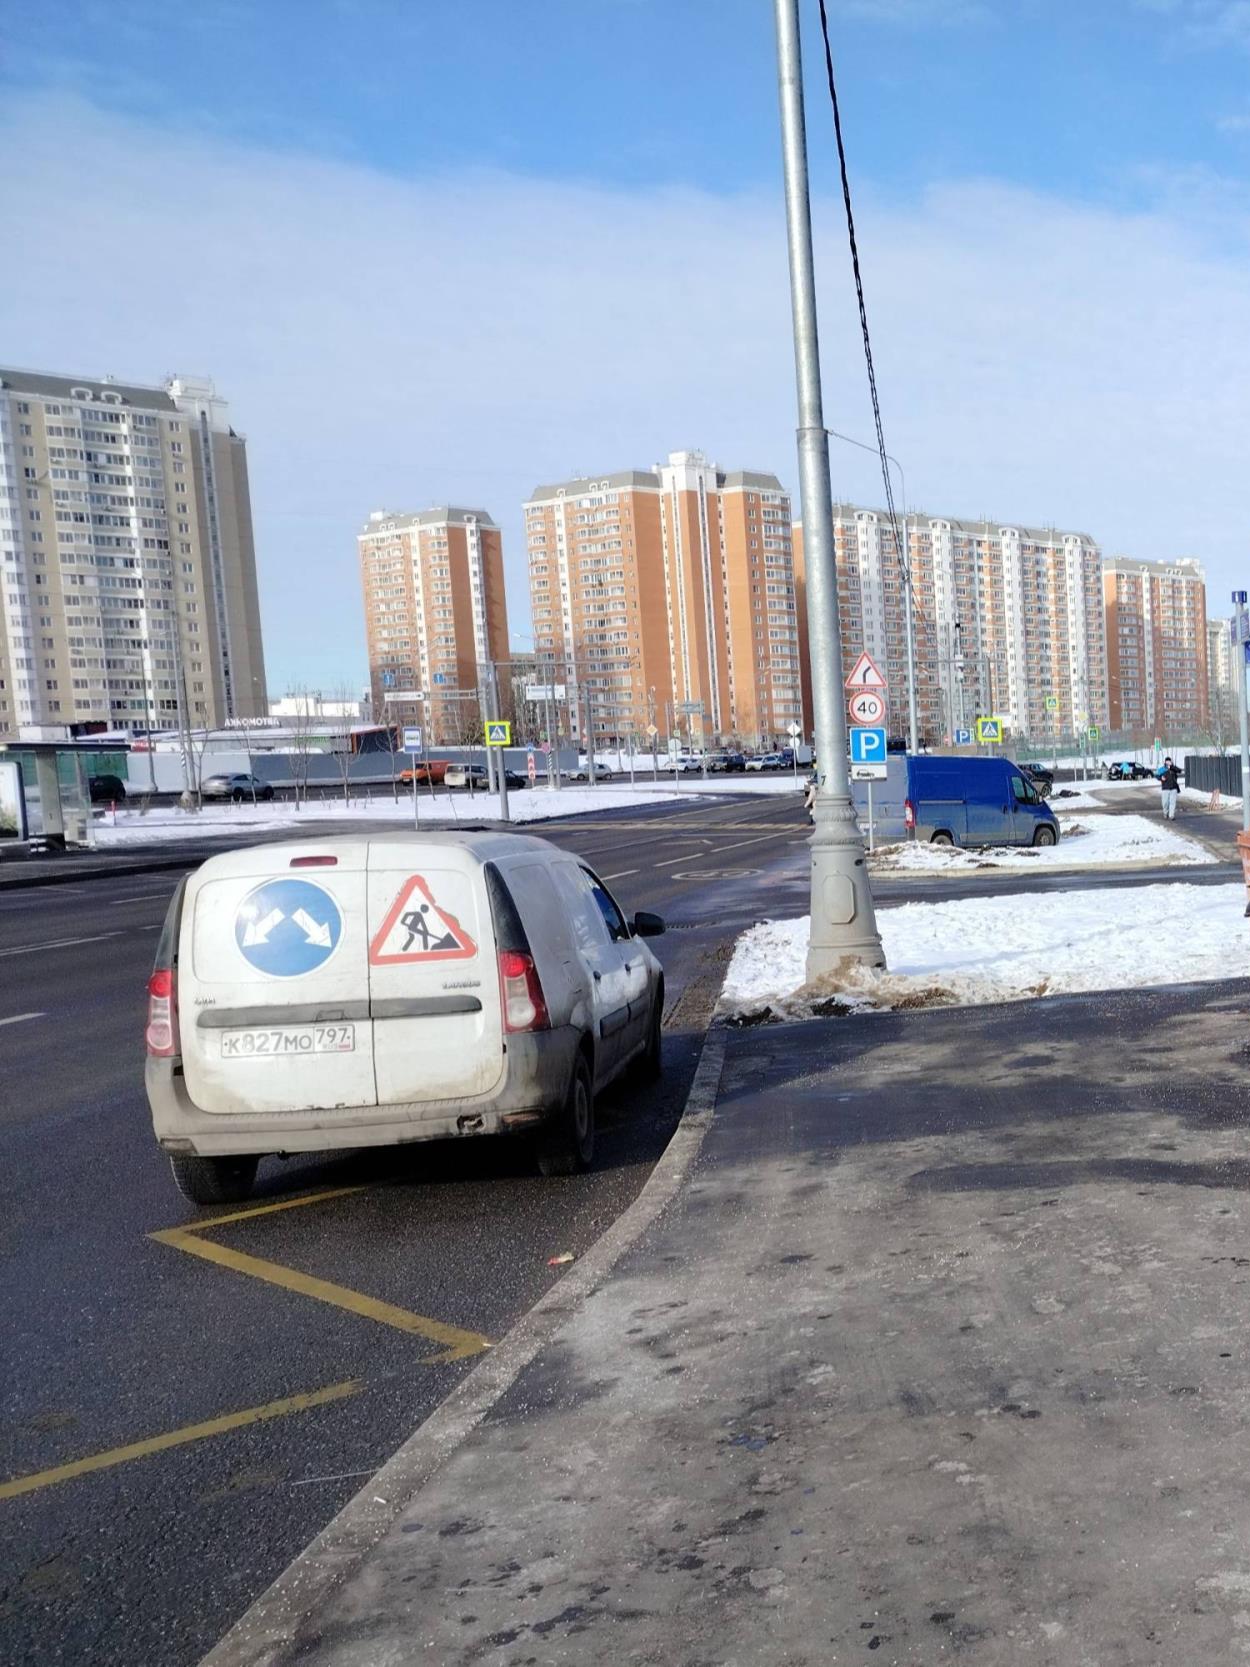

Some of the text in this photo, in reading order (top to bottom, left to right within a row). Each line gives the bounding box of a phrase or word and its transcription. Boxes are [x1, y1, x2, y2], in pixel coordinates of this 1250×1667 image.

[856, 700, 878, 715] 40
[859, 732, 880, 760] P
[227, 1028, 348, 1055] К827МО 797
